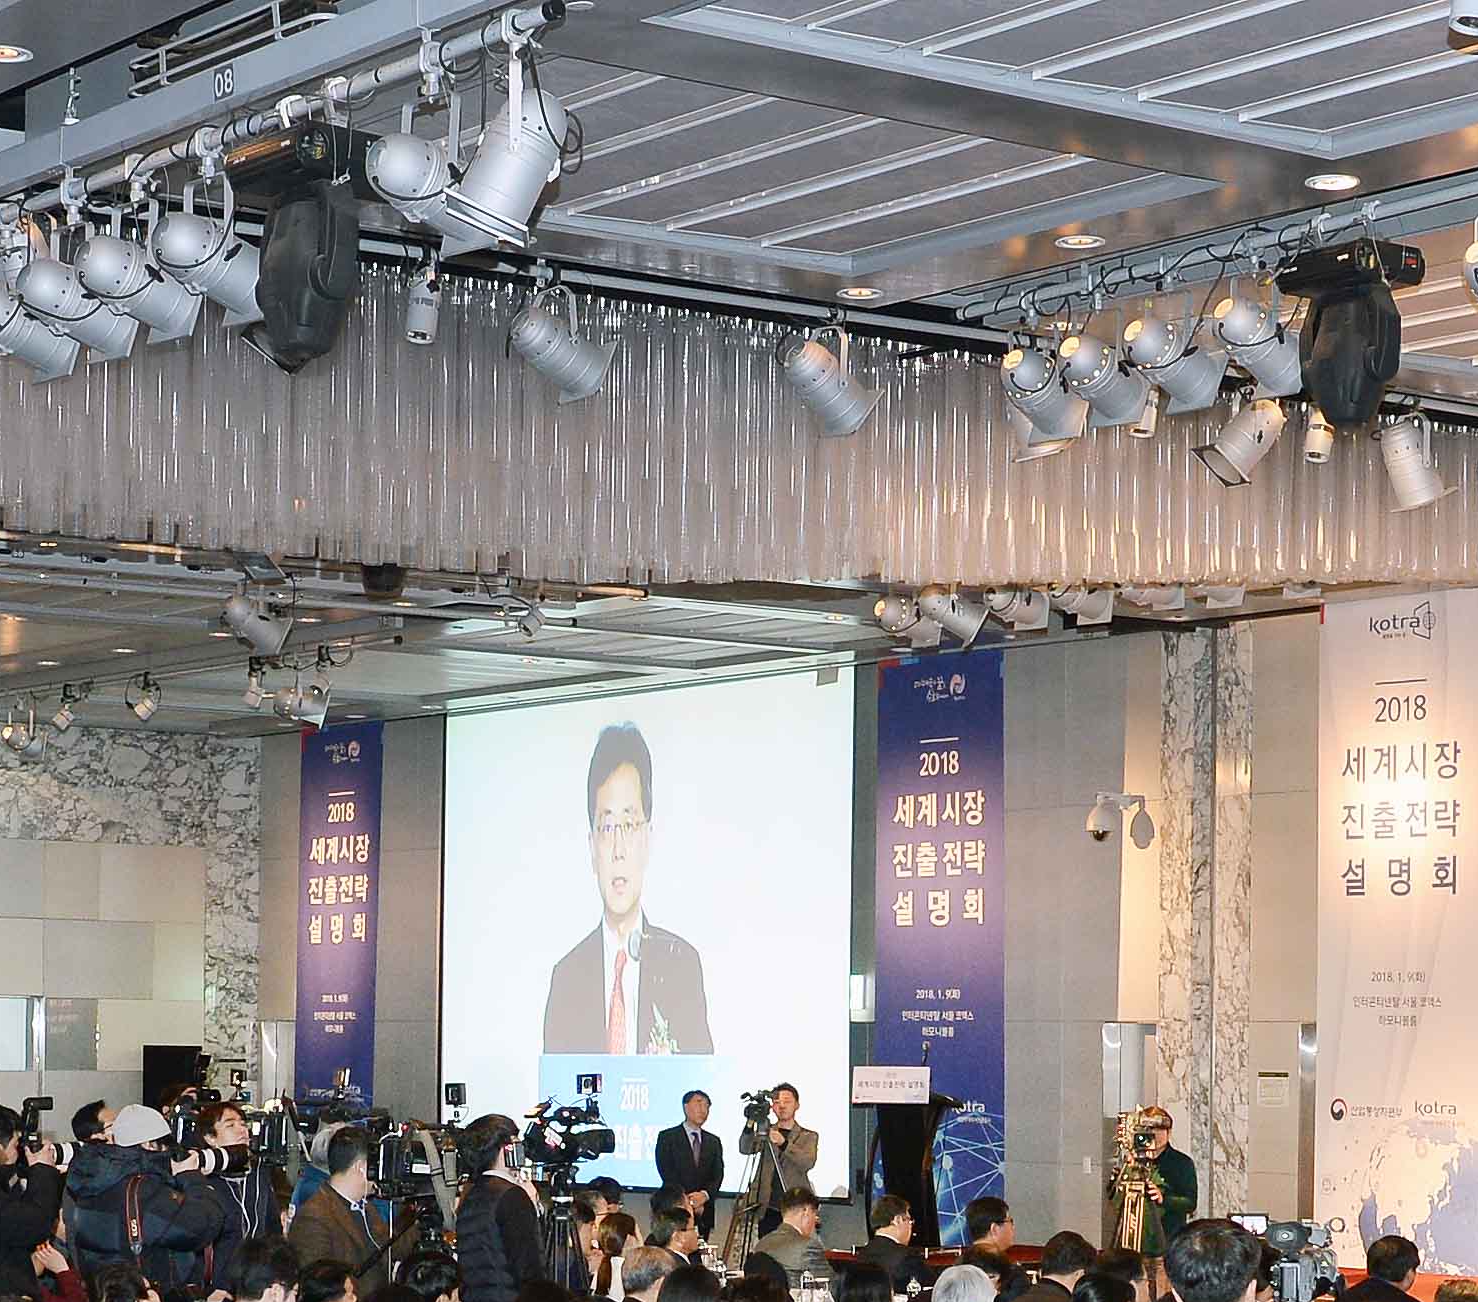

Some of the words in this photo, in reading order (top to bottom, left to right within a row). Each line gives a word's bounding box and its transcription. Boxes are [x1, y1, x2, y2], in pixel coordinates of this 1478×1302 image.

[214, 68, 234, 97] 08
[1369, 614, 1421, 635] kotra
[1374, 694, 1427, 723] 2018
[918, 750, 960, 777] 2018
[1341, 740, 1462, 784] 세계시장
[327, 802, 356, 823] 2018
[892, 789, 986, 829] 세계시장
[1341, 799, 1461, 840] 진출전략
[308, 833, 370, 865] 세계시장
[892, 839, 987, 878] 진출전략
[308, 873, 369, 905] 진출전략
[620, 1082, 650, 1112] 2018
[1414, 1099, 1458, 1117] kotra
